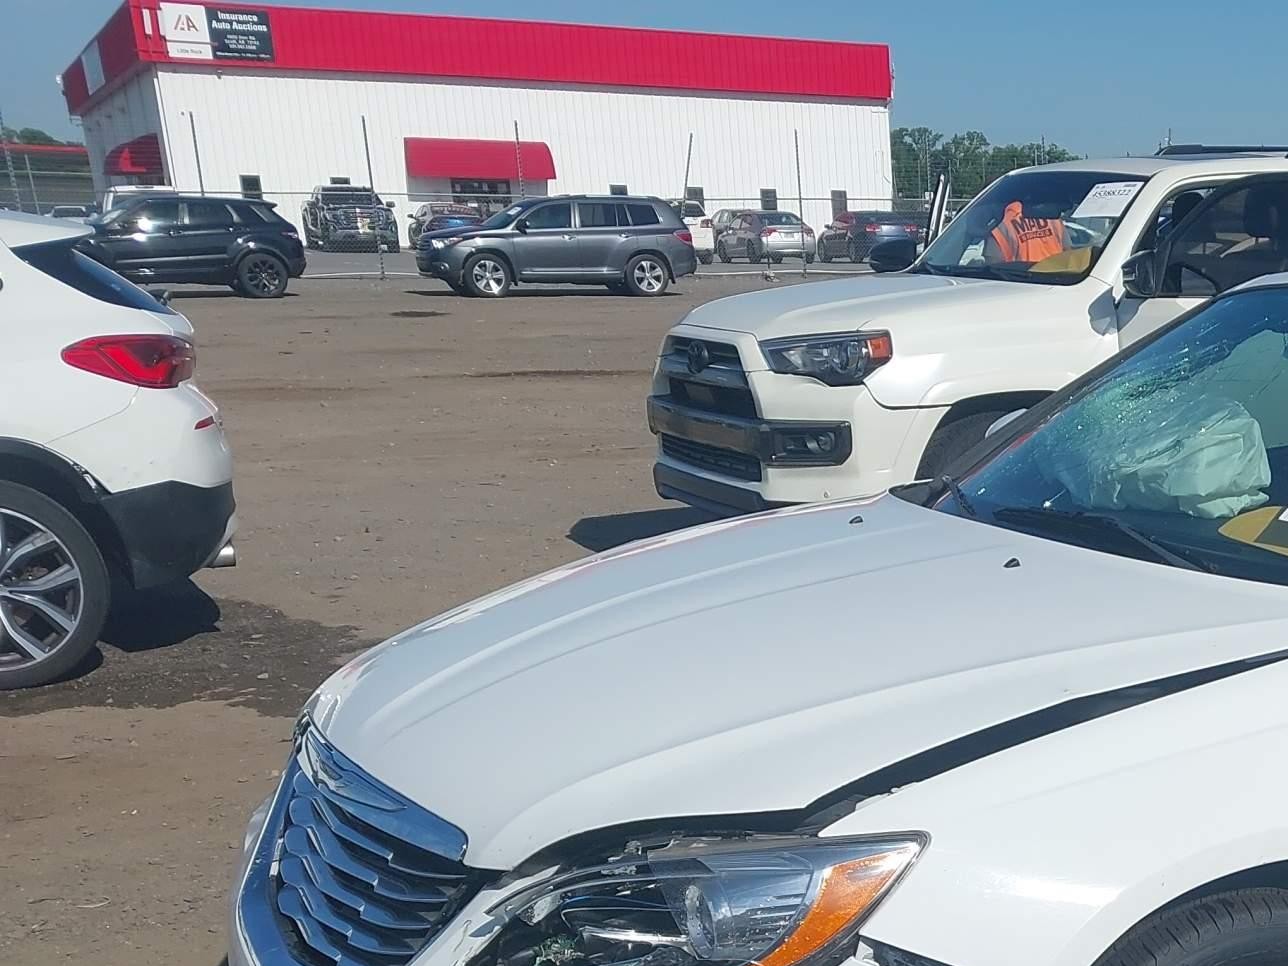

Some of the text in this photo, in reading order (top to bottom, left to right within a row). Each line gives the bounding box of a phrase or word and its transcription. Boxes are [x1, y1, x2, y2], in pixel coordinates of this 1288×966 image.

[217, 11, 258, 21] Insurance
[211, 20, 268, 32] Auto Auctions
